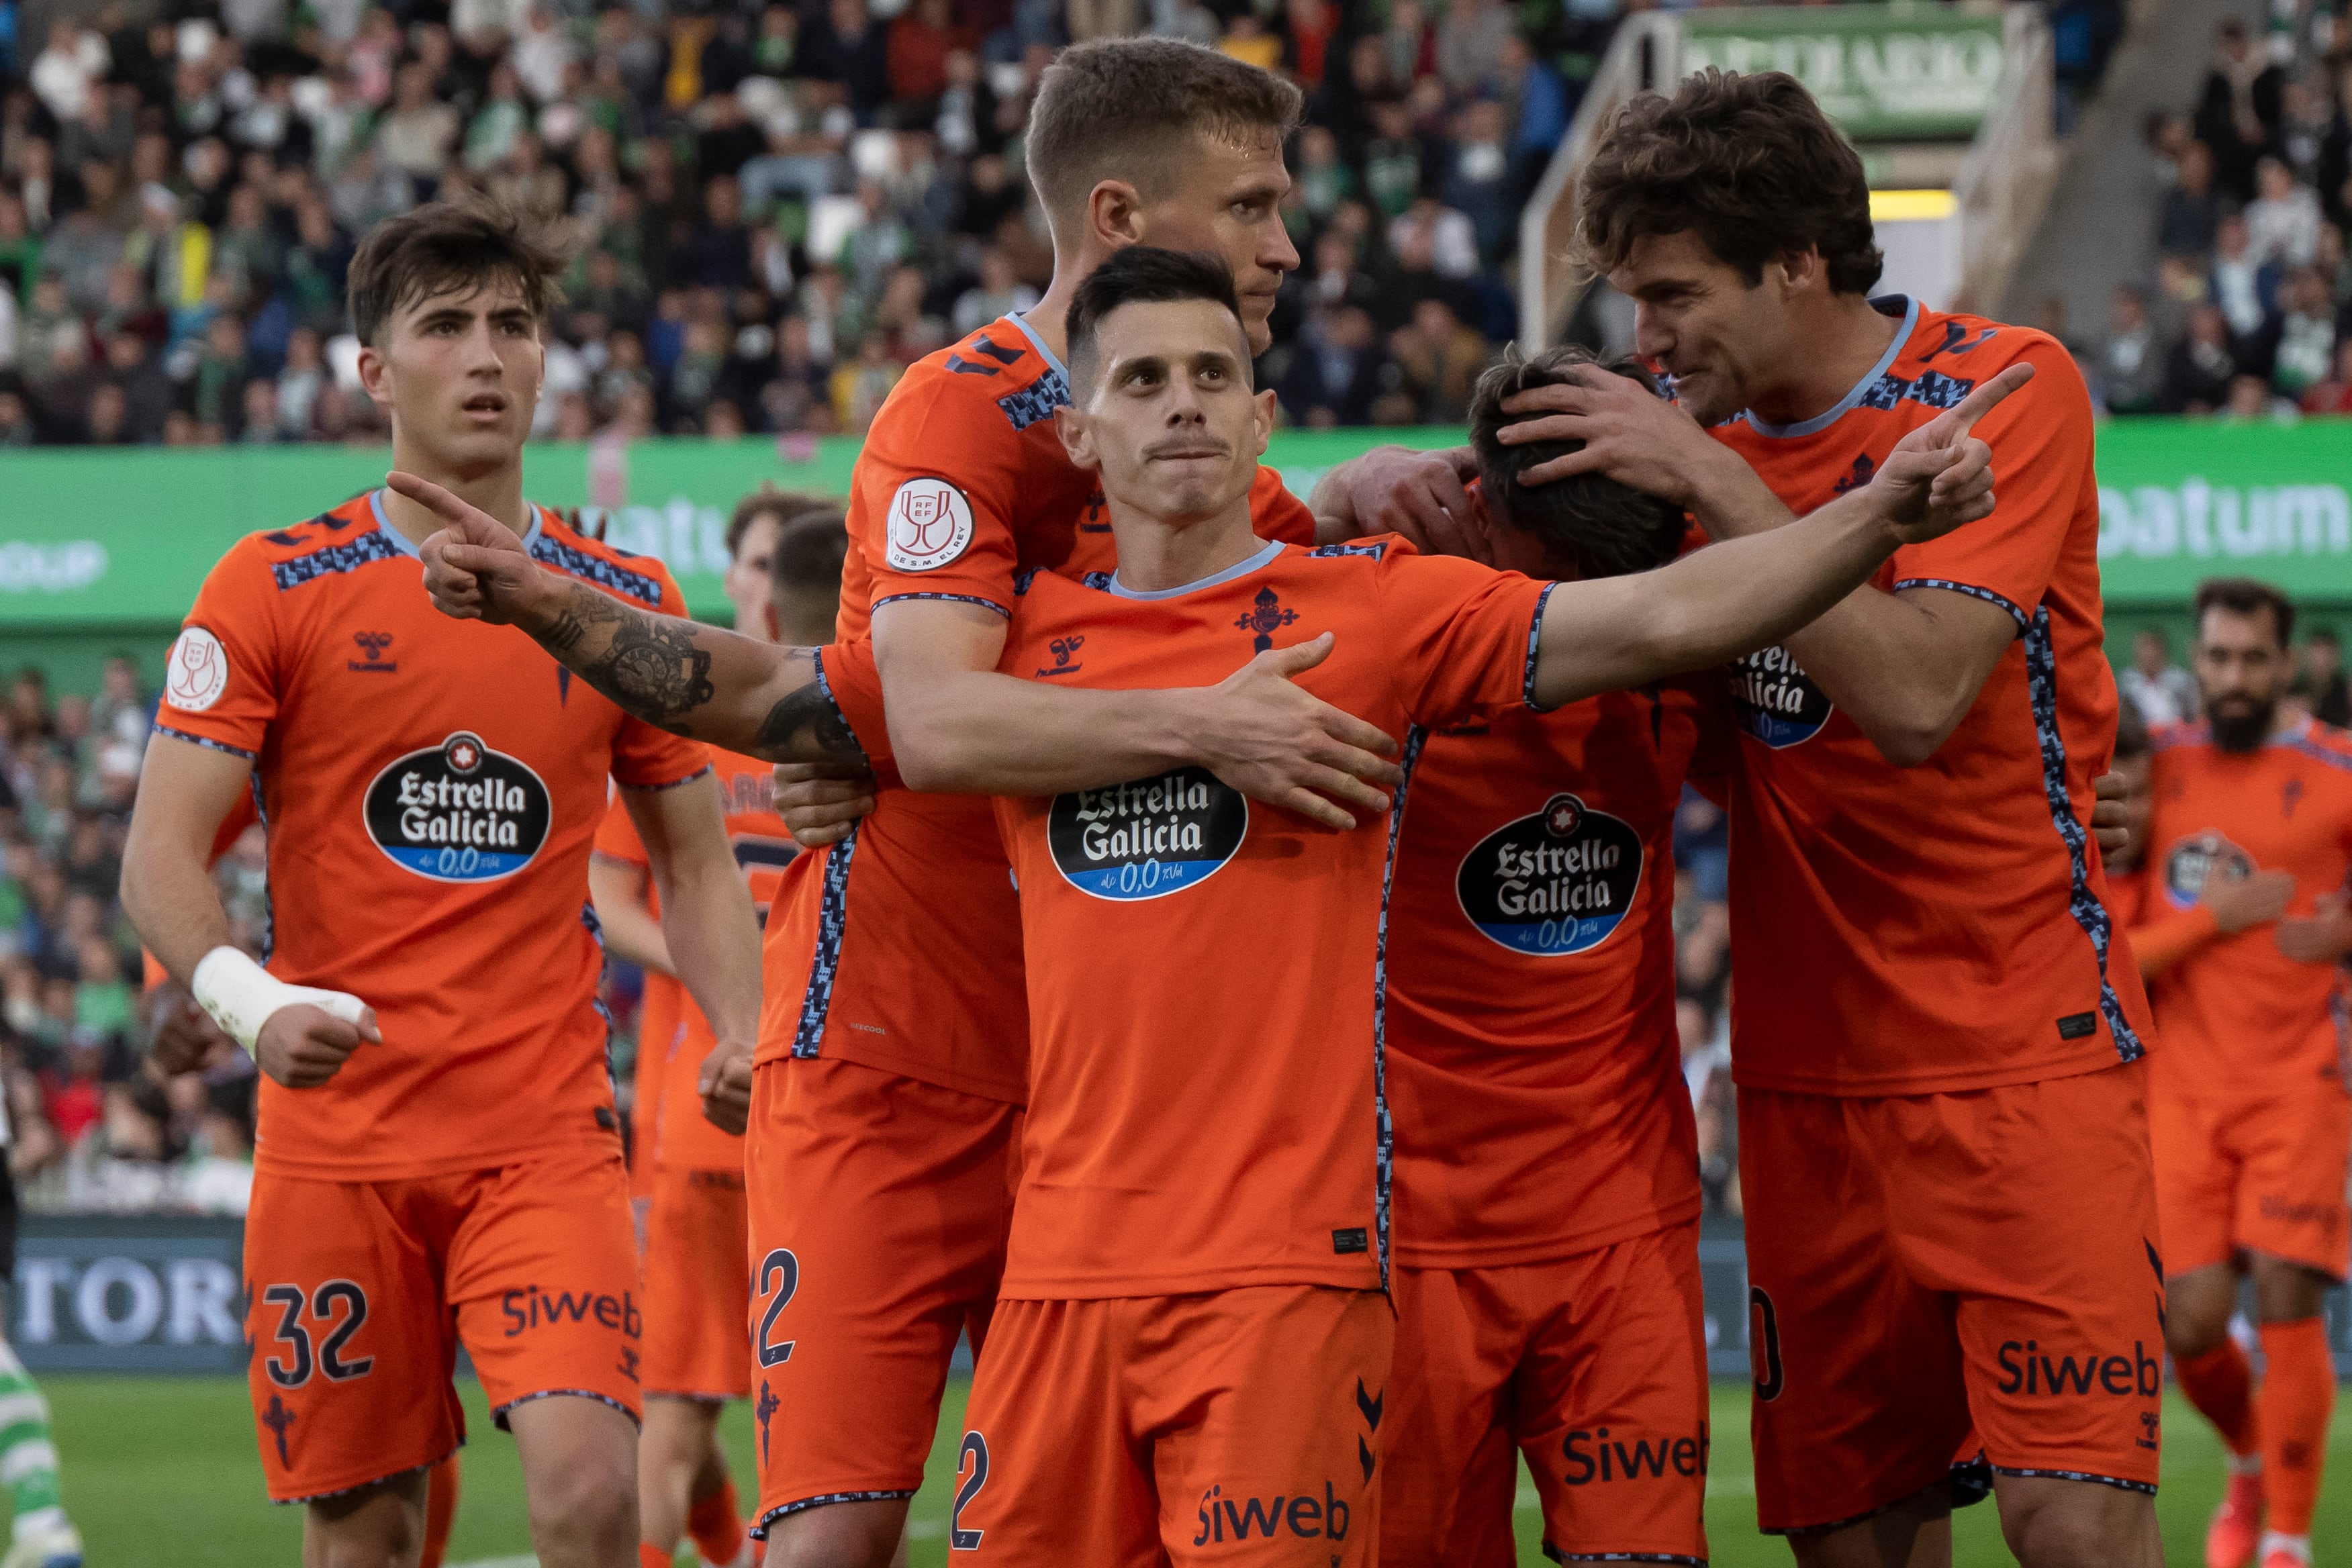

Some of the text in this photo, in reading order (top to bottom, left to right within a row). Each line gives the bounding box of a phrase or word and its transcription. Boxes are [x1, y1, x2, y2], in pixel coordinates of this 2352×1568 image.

[939, 551, 953, 560] EL
[953, 526, 966, 547] REY
[397, 771, 526, 813] Estrella
[1076, 775, 1209, 822] Estrella
[401, 805, 518, 848] Galicia
[1082, 814, 1203, 861] Galicia
[438, 845, 479, 876] 0,0
[1120, 857, 1160, 893] 0,0
[1493, 838, 1621, 878] Estrella
[1497, 874, 1612, 916] Galicia
[1538, 914, 1579, 948] 0,0
[503, 1284, 643, 1340] Siweb
[757, 1248, 799, 1369] 2
[263, 1278, 375, 1390] 32
[1997, 1340, 2159, 1398] Siweb
[949, 1430, 990, 1551] 2
[1193, 1481, 1350, 1547] Siweb
